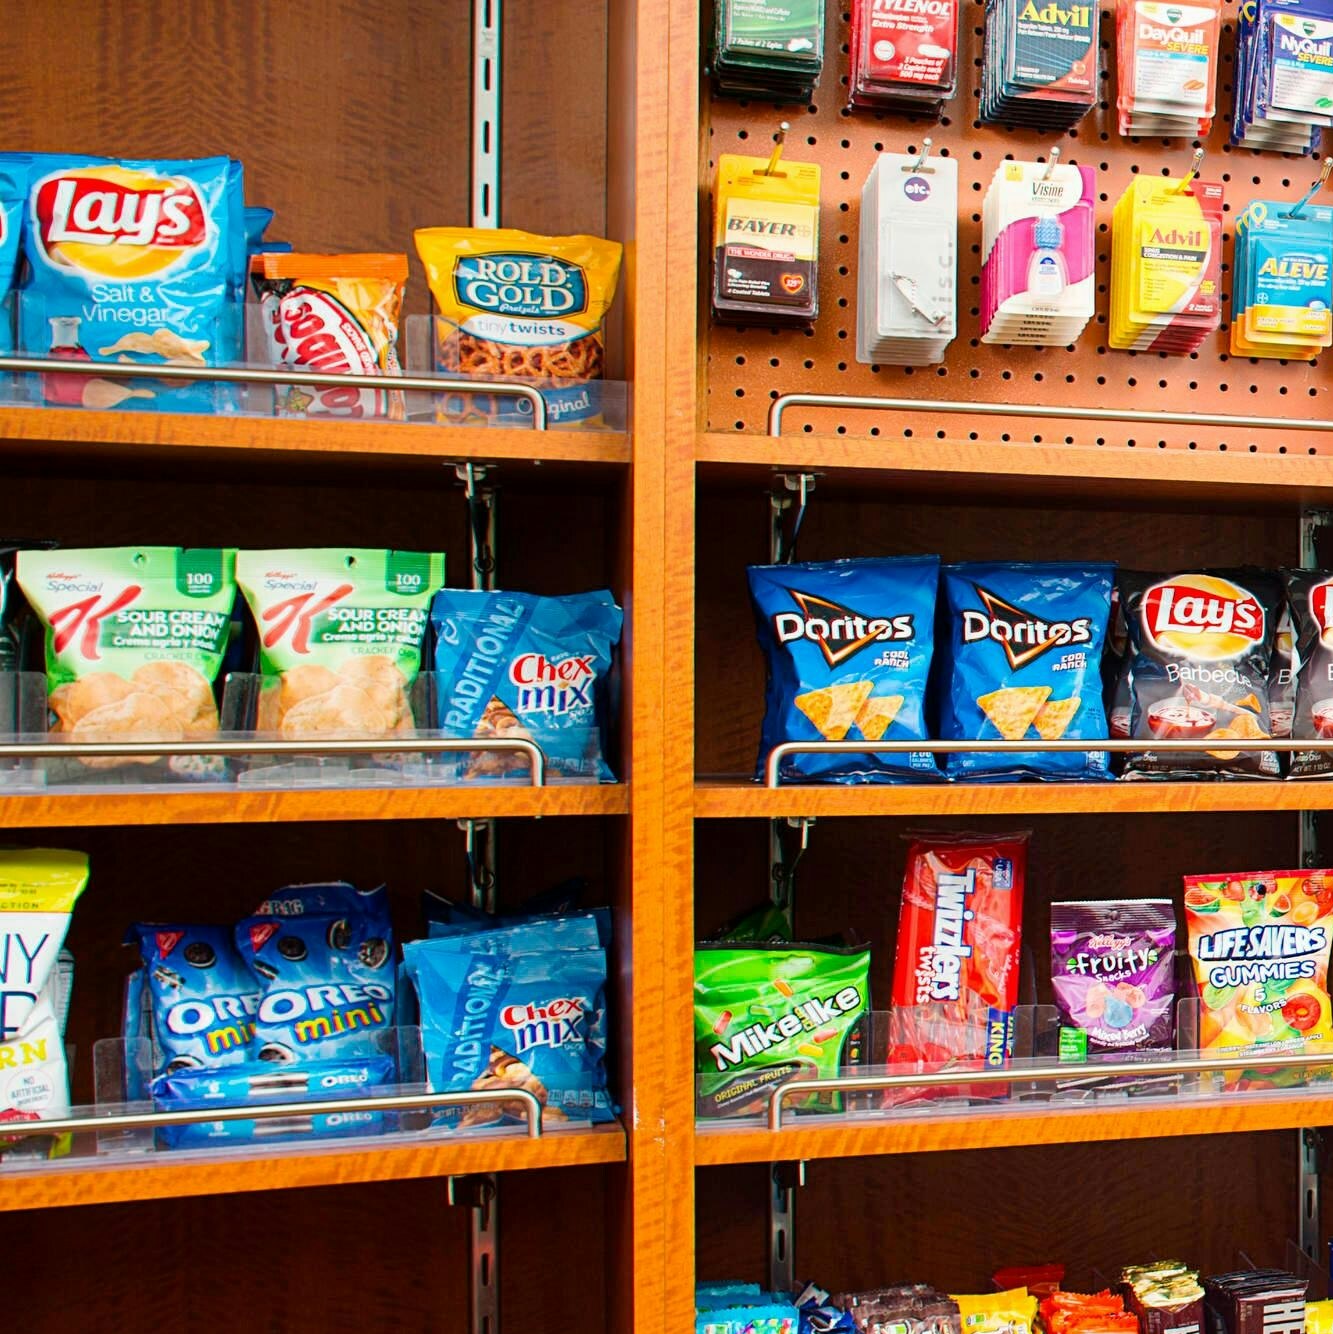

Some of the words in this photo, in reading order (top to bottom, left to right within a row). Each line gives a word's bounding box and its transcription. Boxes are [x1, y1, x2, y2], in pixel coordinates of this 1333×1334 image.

[1019, 0, 1091, 28] Advil
[897, 21, 934, 33] Strength
[1139, 24, 1204, 45] DayQuil
[1167, 41, 1209, 55] SEVERE
[1281, 35, 1332, 55] NyQuil
[1297, 53, 1333, 66] SEVERE
[1032, 181, 1064, 198] Visine
[50, 180, 193, 245] Lay's
[728, 218, 796, 236] BAYER
[1150, 228, 1202, 247] Advil
[476, 257, 565, 287] ROLD
[1258, 257, 1329, 281] ALEVE
[91, 283, 136, 304] Salt
[140, 286, 154, 303] &
[468, 280, 573, 313] GOLD
[82, 302, 168, 325] Vinegar
[477, 318, 507, 337] tiny
[510, 321, 565, 337] twists
[47, 581, 103, 593] Special
[187, 573, 213, 585] 100
[264, 580, 317, 592] Special
[397, 574, 421, 585] 100
[117, 611, 167, 623] SOUR
[170, 611, 224, 627] CREAM
[328, 609, 374, 621] SOUR
[1155, 588, 1256, 633] Lay's
[130, 624, 169, 637] AND
[172, 625, 220, 640] ONION
[340, 622, 374, 633] AND
[776, 613, 913, 642] Doritos
[964, 611, 1090, 644] Doritos
[874, 658, 910, 668] RANCH
[883, 651, 909, 660] COOL
[1061, 653, 1087, 662] COOL
[513, 653, 592, 683] Chex
[1166, 663, 1252, 688] Barbecue
[521, 677, 591, 714] mix
[931, 868, 975, 1001] Twizzlers
[1089, 935, 1133, 950] Kellogg's
[1076, 948, 1150, 976] fruity
[1210, 961, 1316, 988] GUMMIES
[259, 984, 391, 1023] OREO
[1254, 988, 1266, 1002] 5
[504, 998, 583, 1026] Chex
[1241, 999, 1288, 1014] FLAVORS
[295, 1002, 383, 1043] mini
[517, 1016, 581, 1050] mix
[712, 1014, 802, 1071] Mike
[808, 986, 861, 1025] Ike
[988, 1022, 1005, 1066] KING
[714, 1076, 758, 1102] ORIGINAL
[759, 1065, 792, 1086] FRUITS
